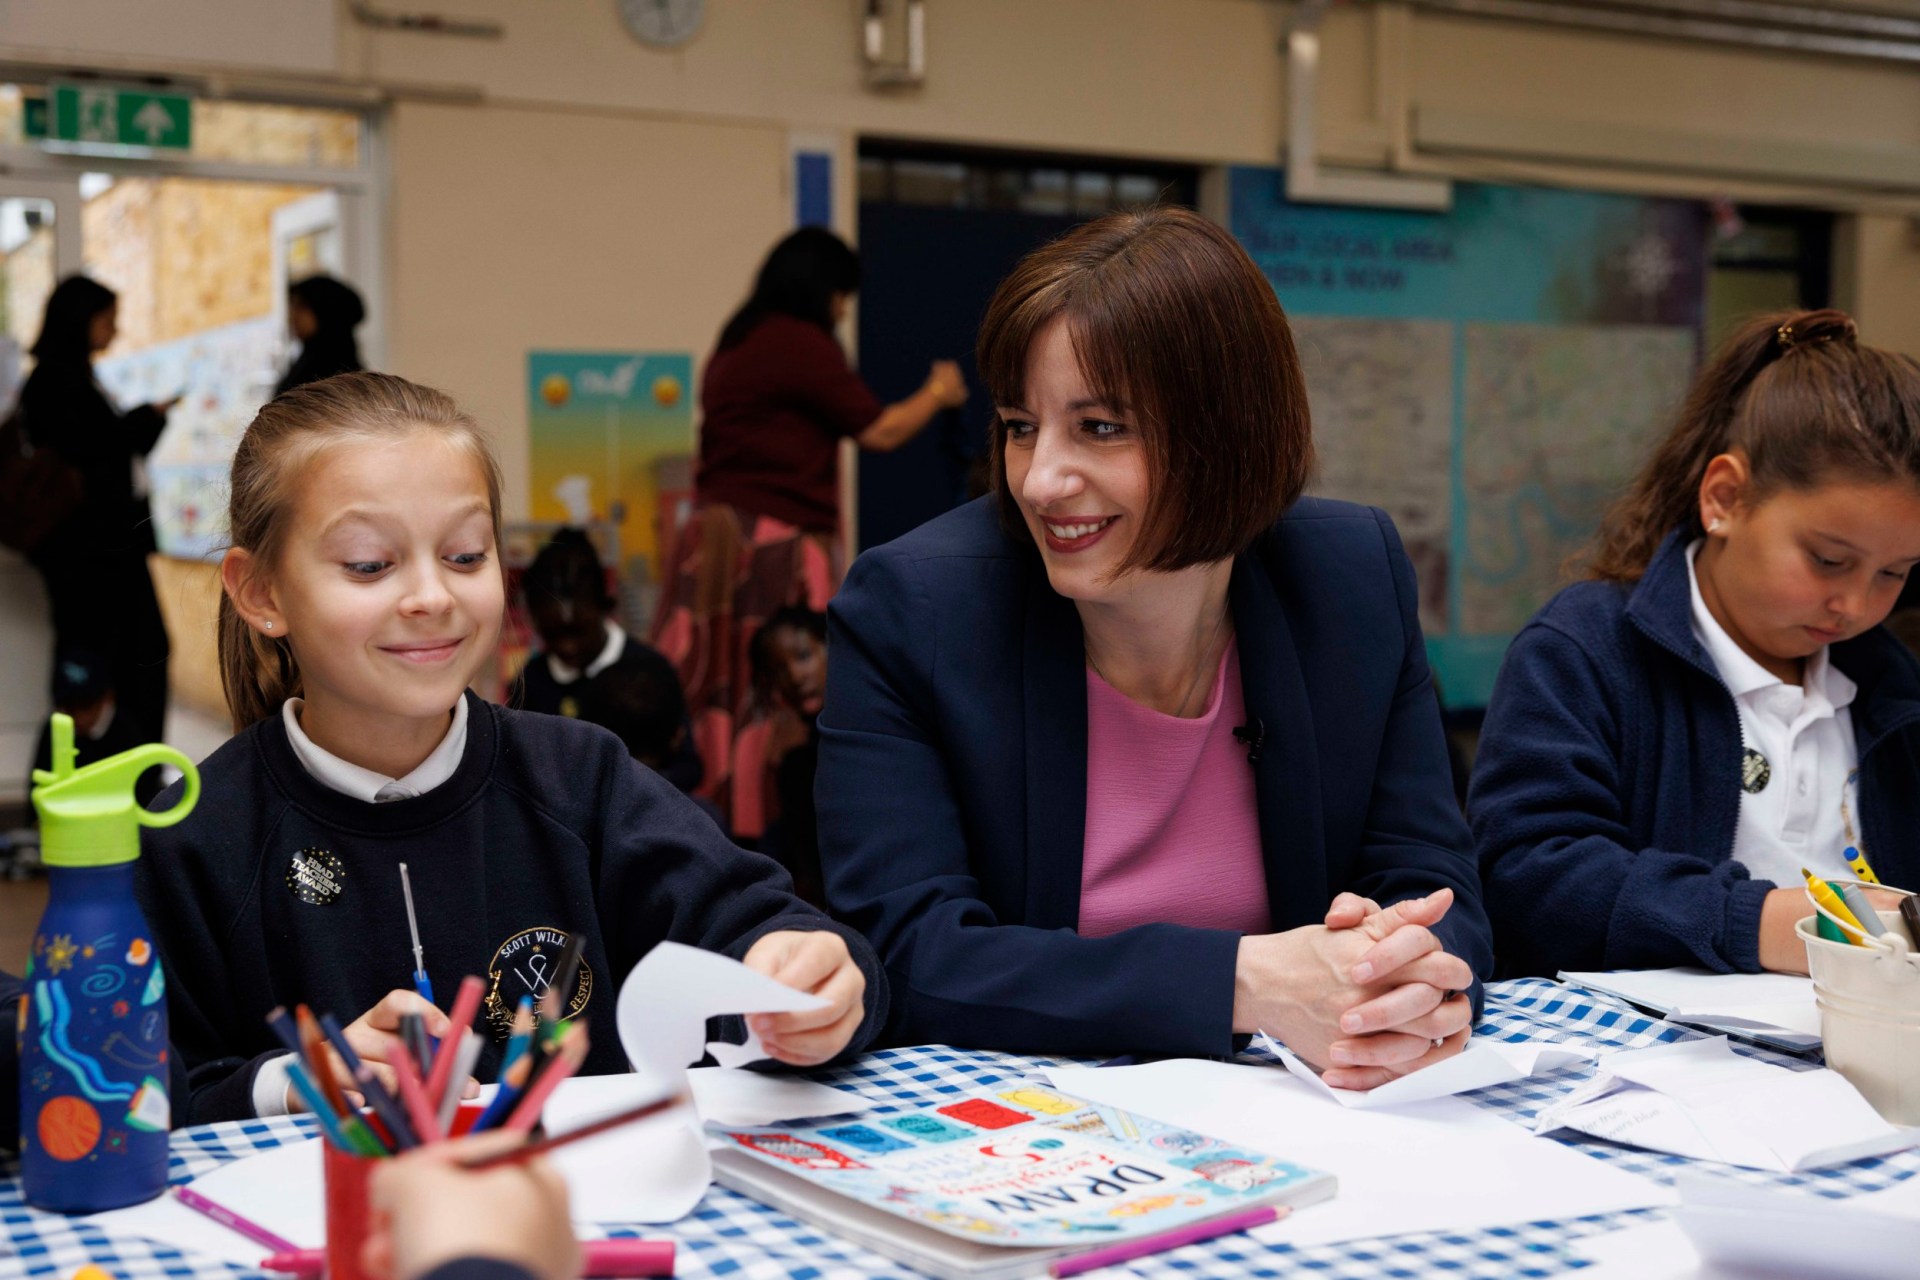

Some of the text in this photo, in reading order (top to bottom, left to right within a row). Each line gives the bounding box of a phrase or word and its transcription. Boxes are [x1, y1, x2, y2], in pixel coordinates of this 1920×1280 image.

[291, 858, 342, 894] TEACHER'S
[292, 871, 331, 896] AWARD
[306, 856, 335, 880] HEAD
[500, 931, 568, 958] SCOTT WILKI
[569, 969, 590, 1010] RESPECT
[985, 1165, 1166, 1214] DRAW
